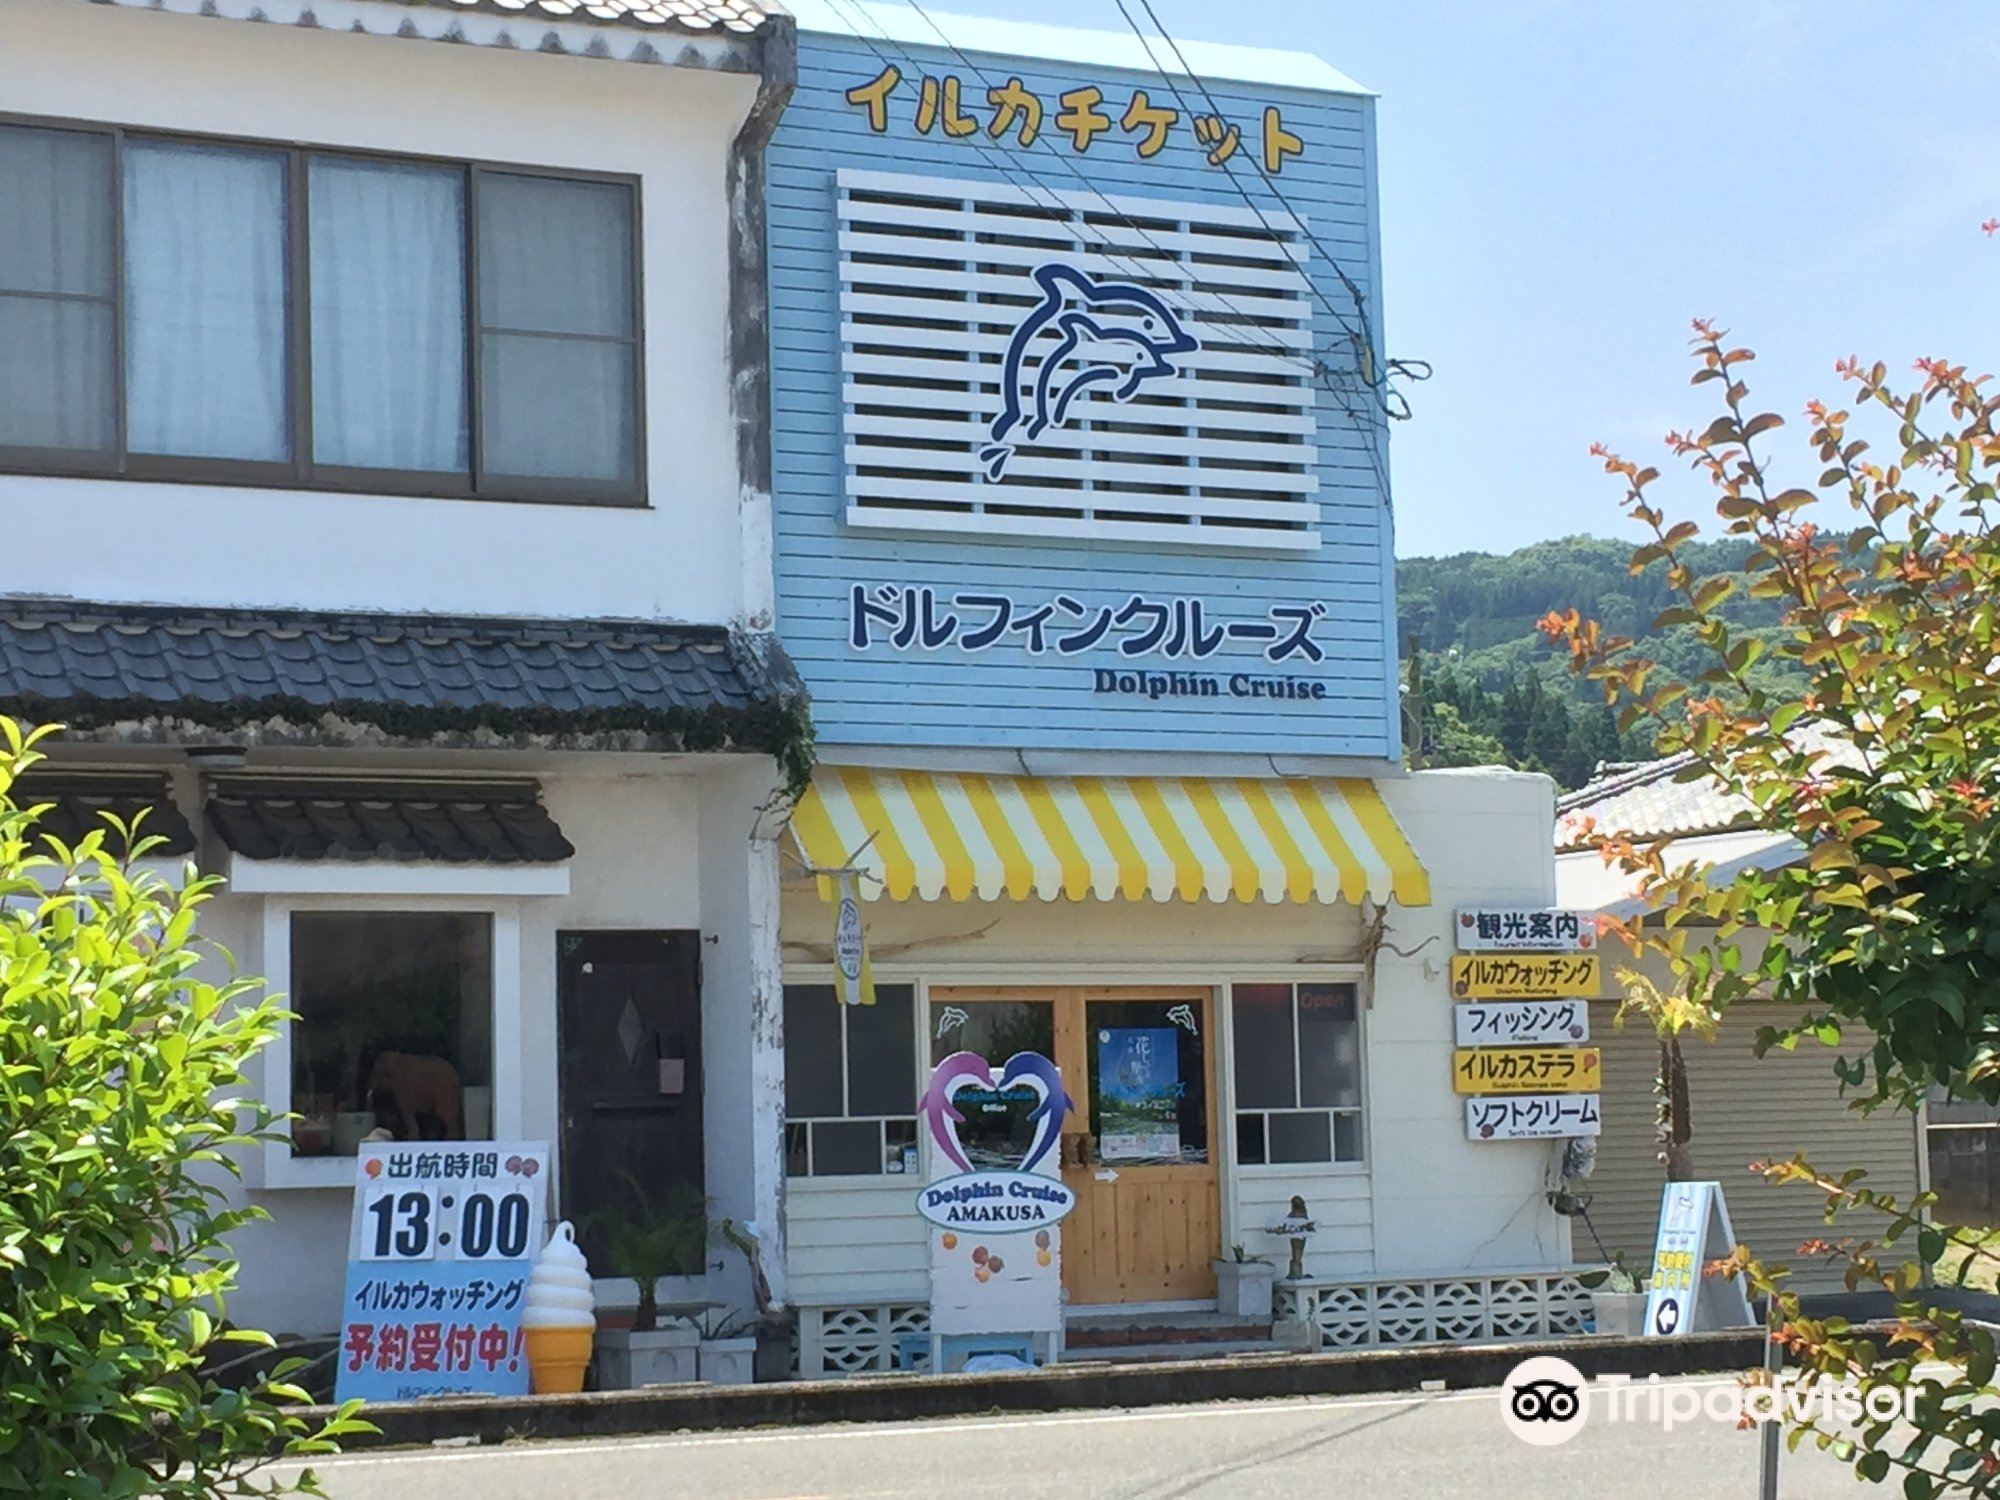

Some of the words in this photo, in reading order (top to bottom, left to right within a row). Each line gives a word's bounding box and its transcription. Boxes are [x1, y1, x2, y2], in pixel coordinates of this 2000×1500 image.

[846, 64, 1304, 174] イルカチケット
[850, 583, 1328, 665] ドルフィンクルーズ
[1094, 669, 1219, 700] Dolphin
[1229, 673, 1326, 700] Cruise
[1477, 912, 1579, 940] 観光案内
[1460, 956, 1594, 986] イルカウォッチング
[1300, 991, 1345, 1009] Open
[1467, 1002, 1576, 1035] フィッシング
[1460, 1052, 1576, 1080] イルカステラ
[1472, 1100, 1599, 1128] ソフトクリーム
[388, 1152, 498, 1179] 出航時間
[926, 1180, 1004, 1208] Dolphin
[1008, 1180, 1068, 1205] Cruise
[369, 1191, 530, 1258] 13:00
[946, 1204, 1046, 1221] AMAKUSA
[355, 1278, 525, 1311] イルカウォッチング
